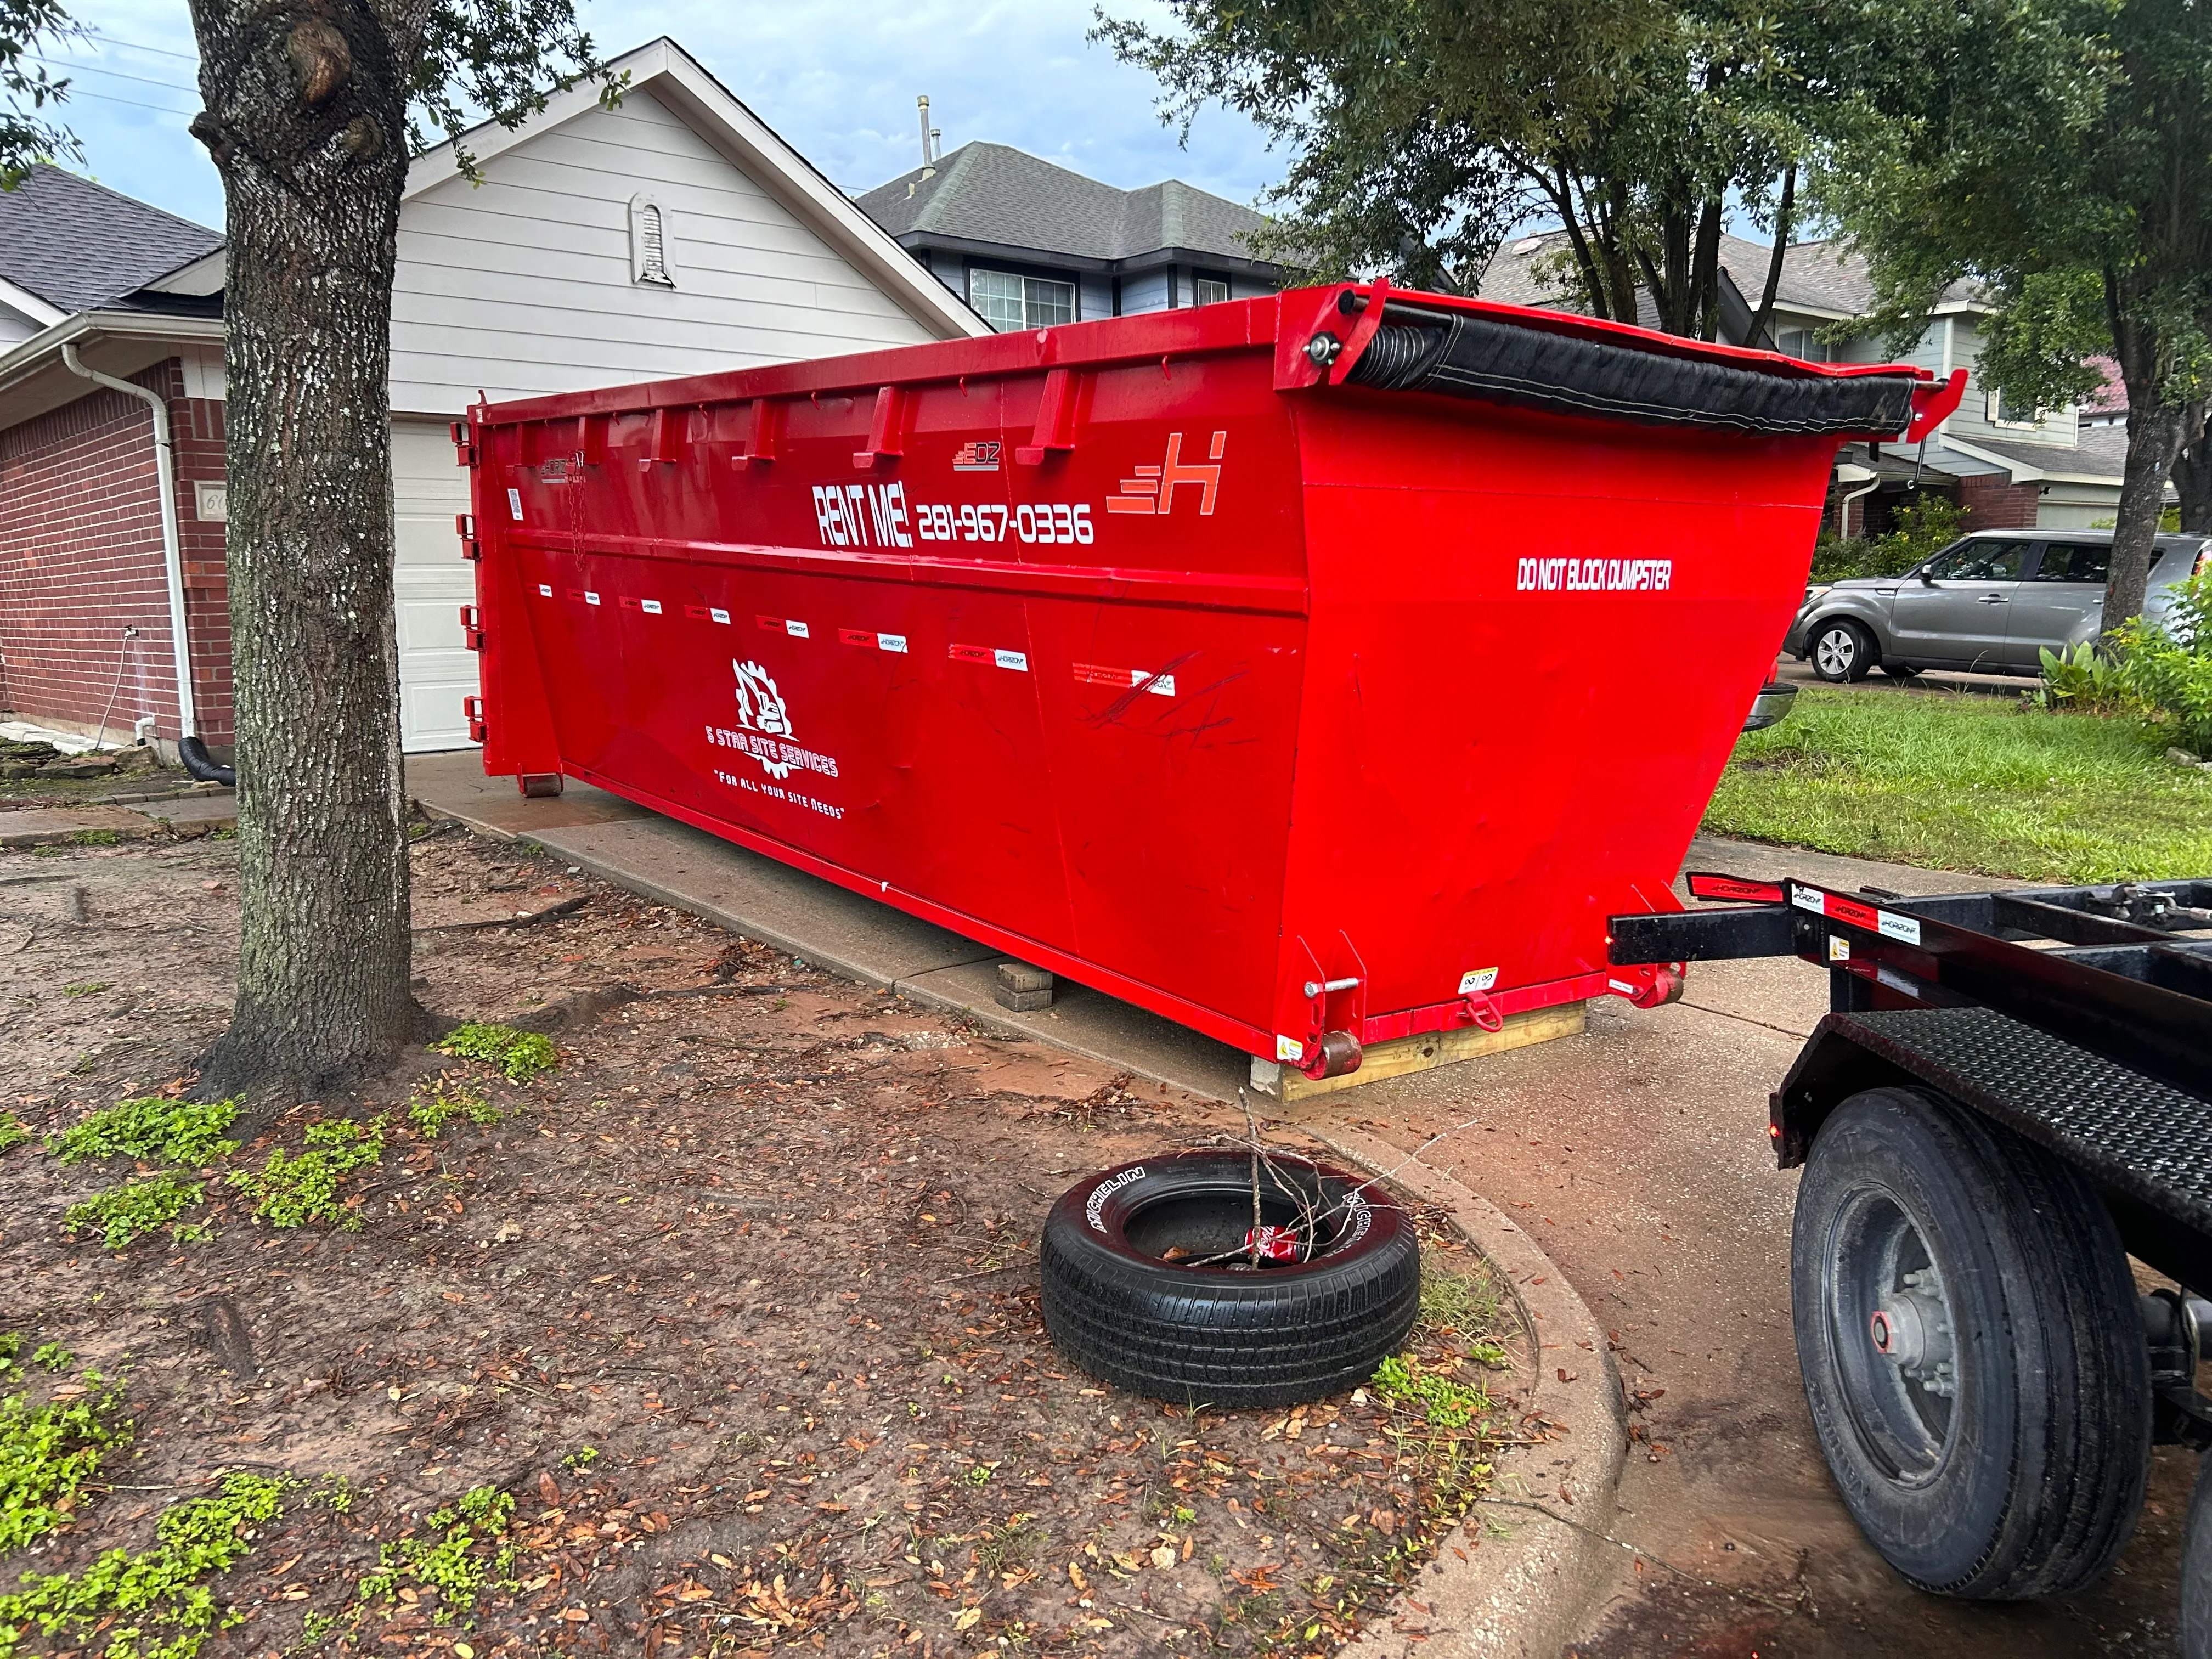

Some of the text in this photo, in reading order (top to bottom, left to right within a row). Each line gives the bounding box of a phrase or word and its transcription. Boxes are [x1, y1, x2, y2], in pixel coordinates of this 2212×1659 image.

[812, 480, 1094, 548] RENT ME! 281-967-0336
[1517, 557, 1672, 591] DO NOT BLOCK DUMPSTER
[705, 725, 839, 778] 5 STAR SITE SERVICES
[740, 778, 759, 793] ALL
[761, 783, 786, 800] YOUR
[787, 791, 809, 808] SITE
[1881, 918, 1917, 934] HORIZON
[1086, 1165, 1147, 1234] MICHELIN
